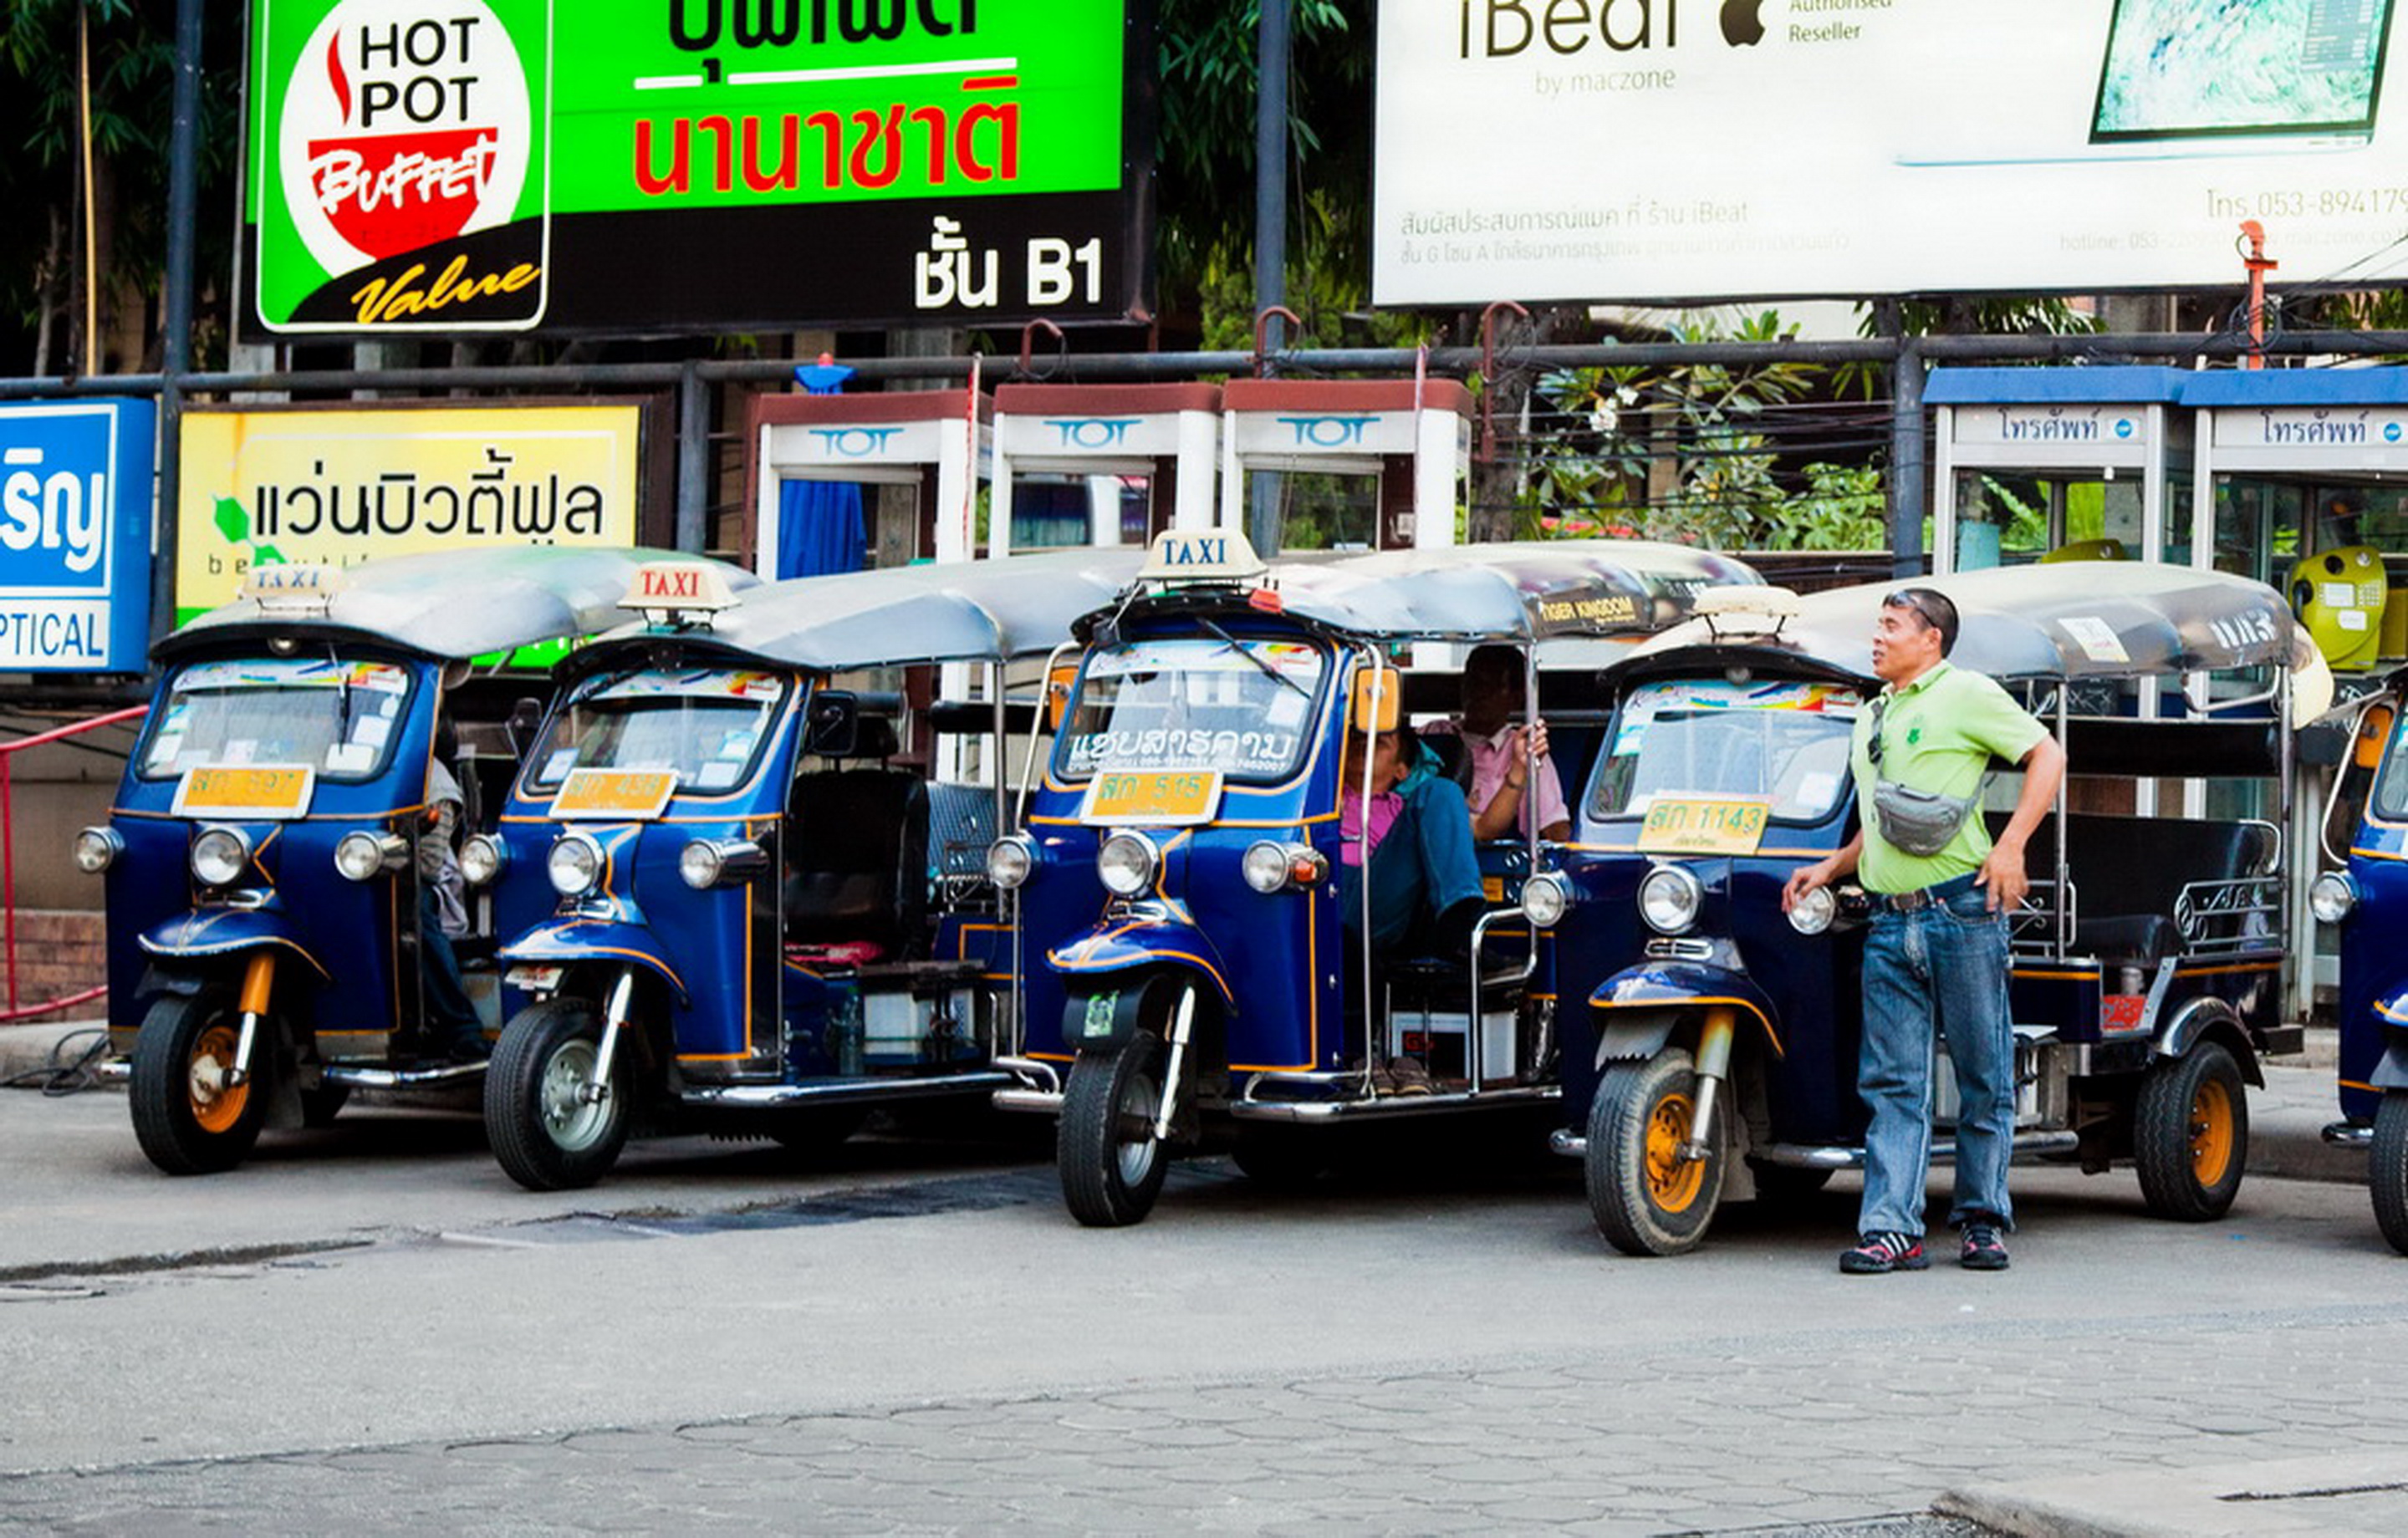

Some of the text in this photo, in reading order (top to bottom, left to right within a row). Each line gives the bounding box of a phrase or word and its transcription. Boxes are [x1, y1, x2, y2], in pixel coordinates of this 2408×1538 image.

[361, 18, 480, 69] HOT
[1789, 22, 1861, 43] Reseller
[1535, 67, 1677, 99] by maczone
[361, 77, 479, 128] POT
[635, 76, 1018, 196] นานาชาติ
[916, 216, 1100, 308] ชั้น B1
[350, 255, 541, 323] Value
[1043, 418, 1143, 446] TOT
[1276, 416, 1382, 446] TOT
[1997, 407, 2100, 440] โทรศัพท์
[2260, 407, 2367, 444] โทรศัพท์
[808, 424, 906, 456] TOT
[1163, 538, 1227, 565] TAXI
[256, 572, 320, 588] TAXI
[640, 570, 699, 597] TAXI
[1700, 806, 1763, 833] 1143
